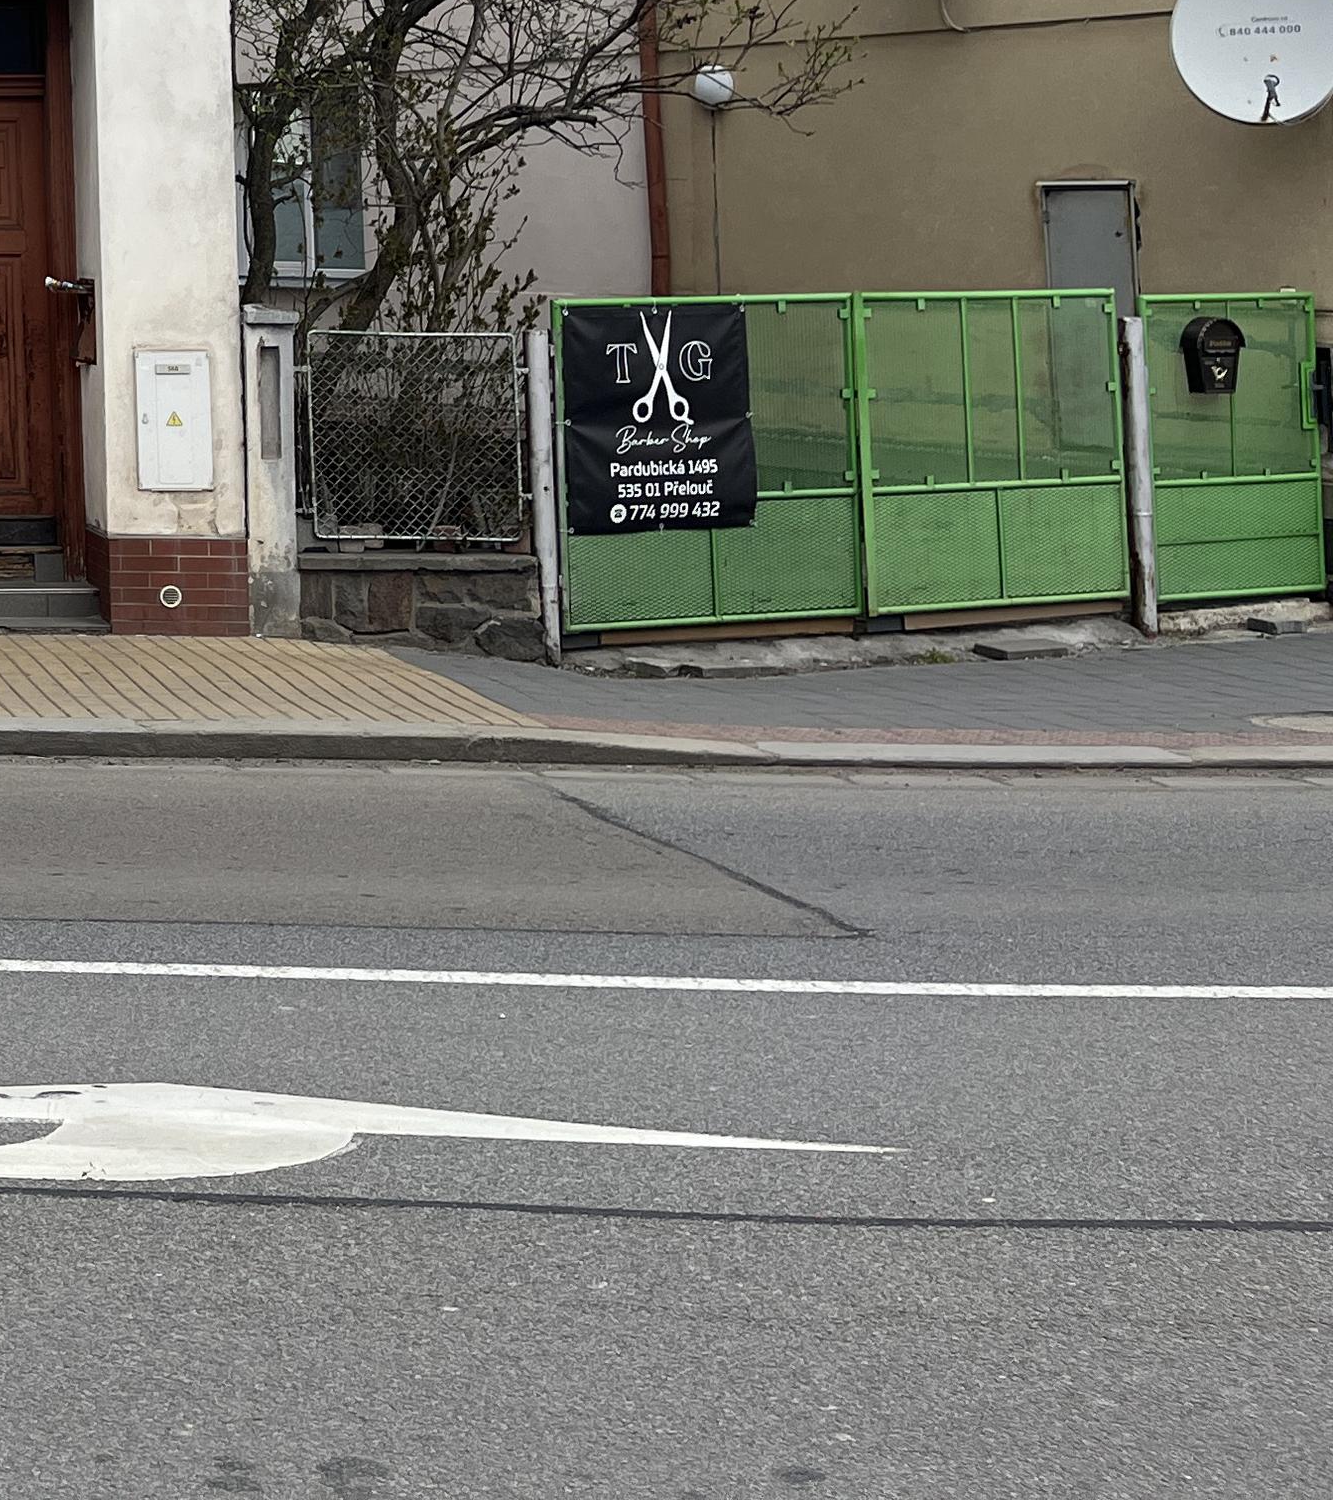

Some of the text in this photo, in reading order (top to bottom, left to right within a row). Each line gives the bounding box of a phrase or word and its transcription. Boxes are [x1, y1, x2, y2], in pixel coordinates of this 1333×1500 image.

[1229, 24, 1301, 36] 840 444 000
[605, 340, 713, 384] T G
[615, 423, 712, 454] Barber Shop
[610, 458, 718, 477] Pardubická 1495
[617, 479, 713, 498] 535 01 Přelouč
[629, 500, 721, 521] 774 999 432
